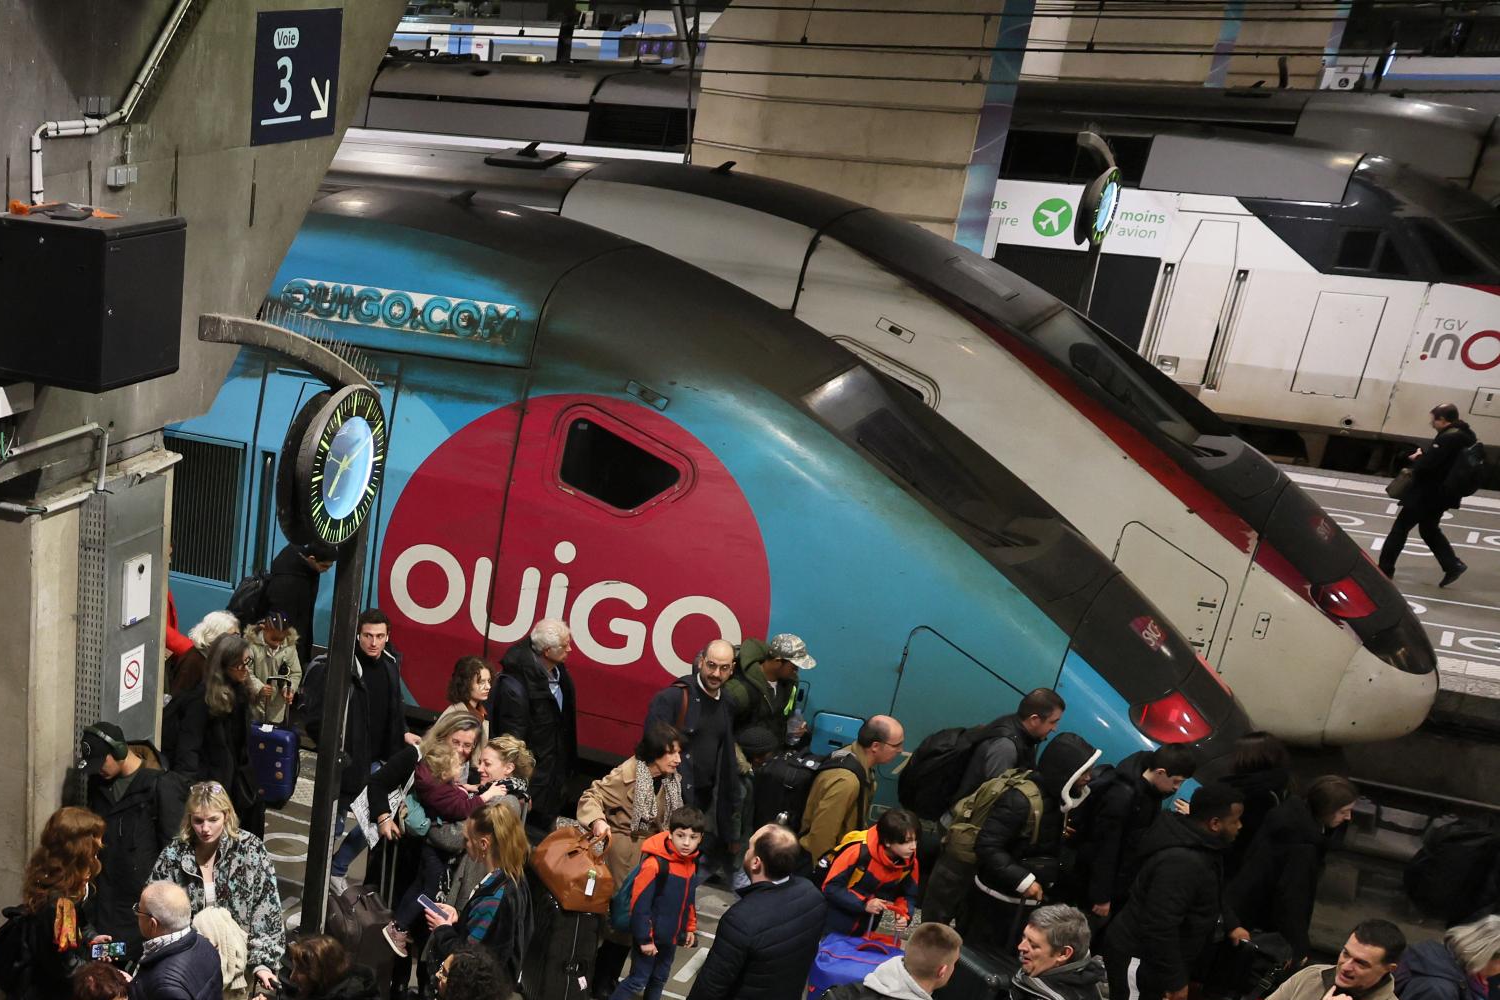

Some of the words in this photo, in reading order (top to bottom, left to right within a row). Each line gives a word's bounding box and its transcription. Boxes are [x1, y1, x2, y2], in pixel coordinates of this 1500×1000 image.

[277, 30, 296, 46] Voie
[273, 56, 293, 113] 3
[1120, 211, 1166, 224] moins
[281, 279, 520, 344] OUIGO.COM
[1435, 317, 1468, 331] TGV
